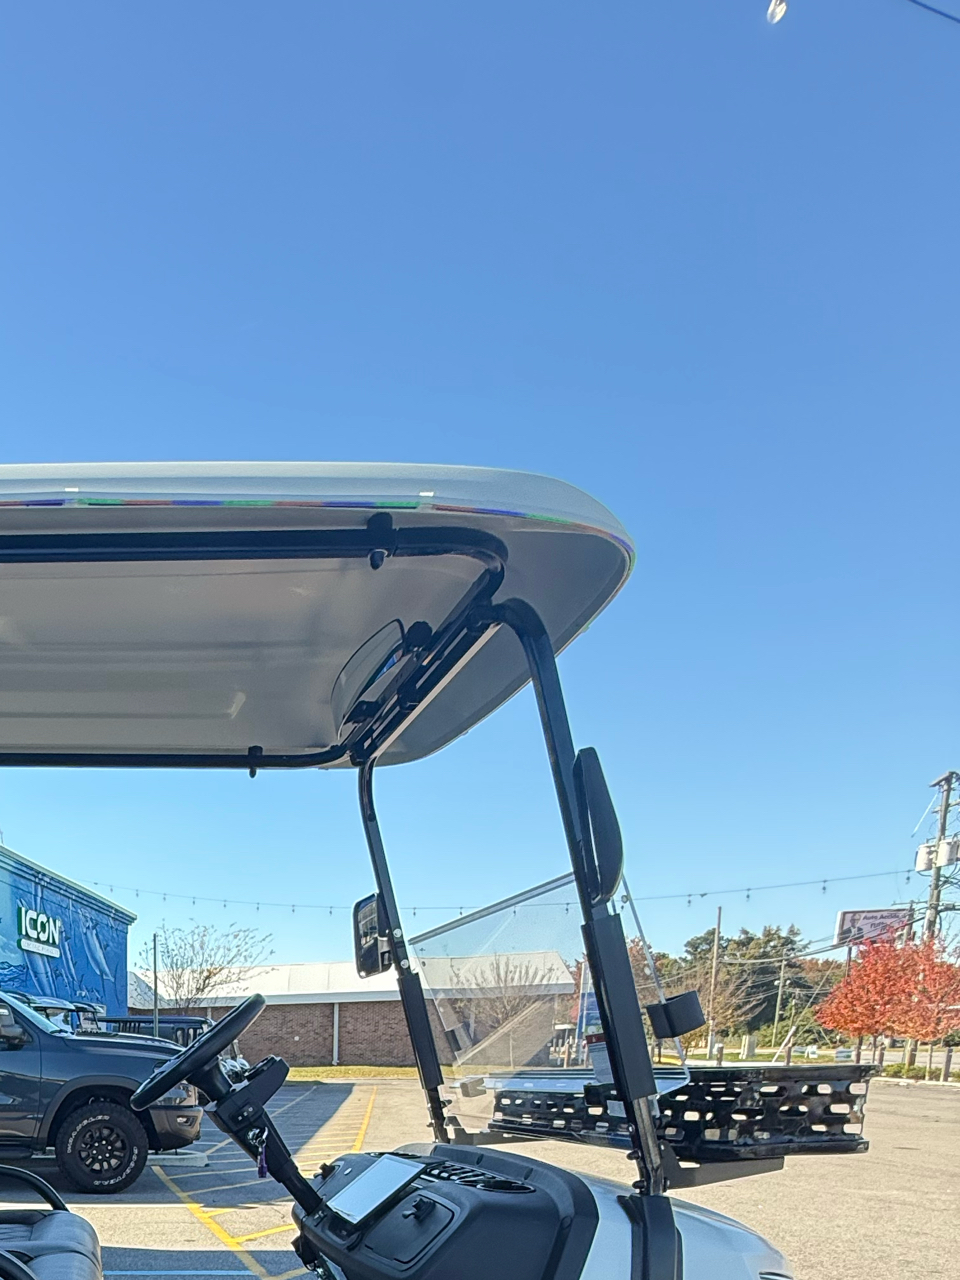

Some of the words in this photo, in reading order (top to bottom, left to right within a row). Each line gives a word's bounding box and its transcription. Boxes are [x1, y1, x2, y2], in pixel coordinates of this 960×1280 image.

[21, 907, 59, 945] ICON
[67, 1115, 110, 1153] WRANGLER
[93, 1146, 138, 1185] GOODYEAR
